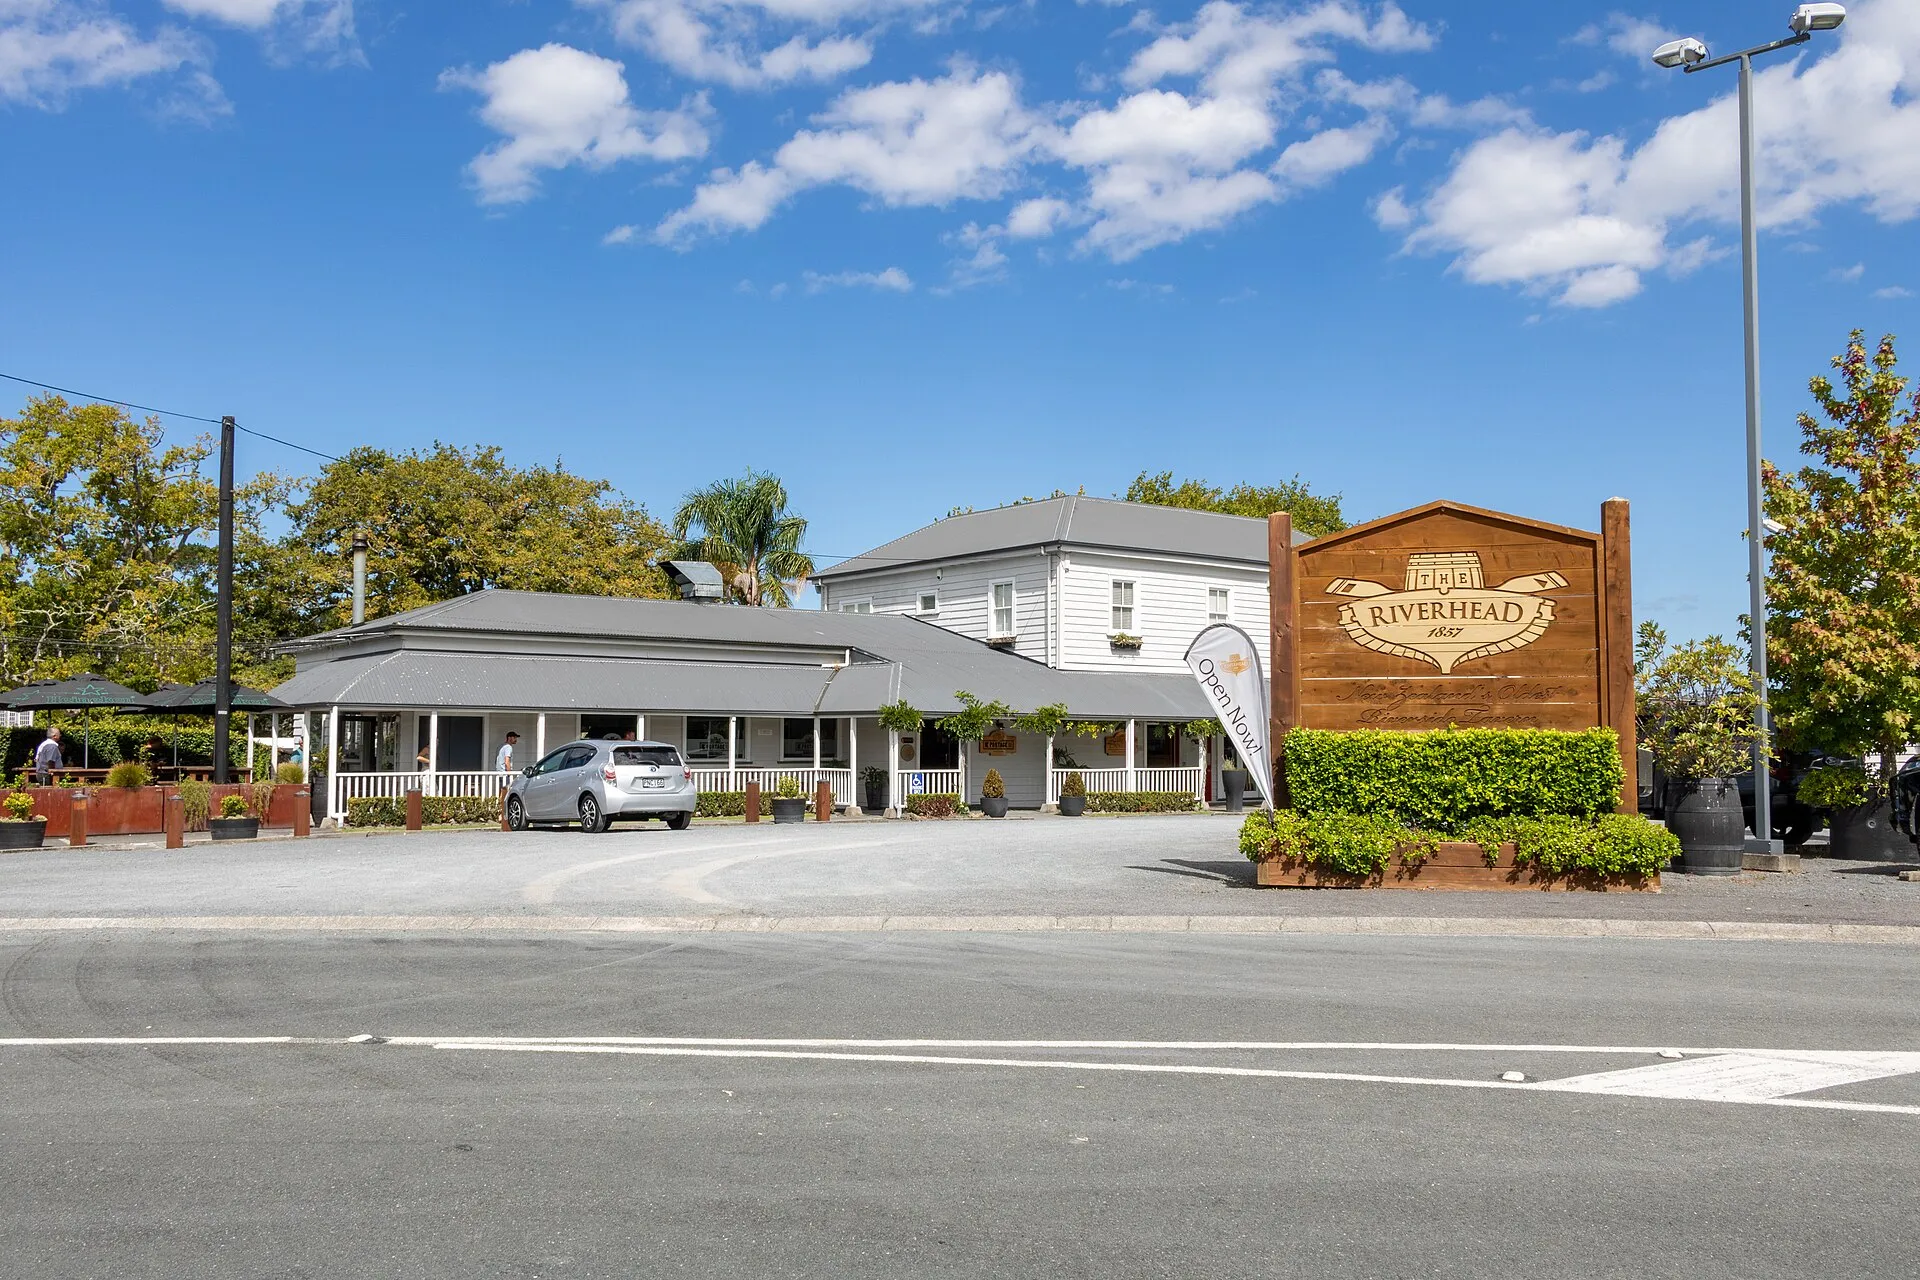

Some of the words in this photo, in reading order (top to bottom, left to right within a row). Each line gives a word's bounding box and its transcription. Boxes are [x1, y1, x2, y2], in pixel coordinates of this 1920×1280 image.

[1420, 572, 1468, 585] THE
[1368, 600, 1524, 627] RIVERHEAD
[1427, 626, 1464, 639] 1857
[1198, 658, 1231, 708] Open
[1226, 704, 1263, 757] Now!
[1335, 683, 1388, 701] New
[1385, 683, 1492, 711] Zealand's
[1497, 683, 1562, 699] Oldest
[1355, 707, 1457, 723] Riverside
[1458, 704, 1539, 723] Tavern
